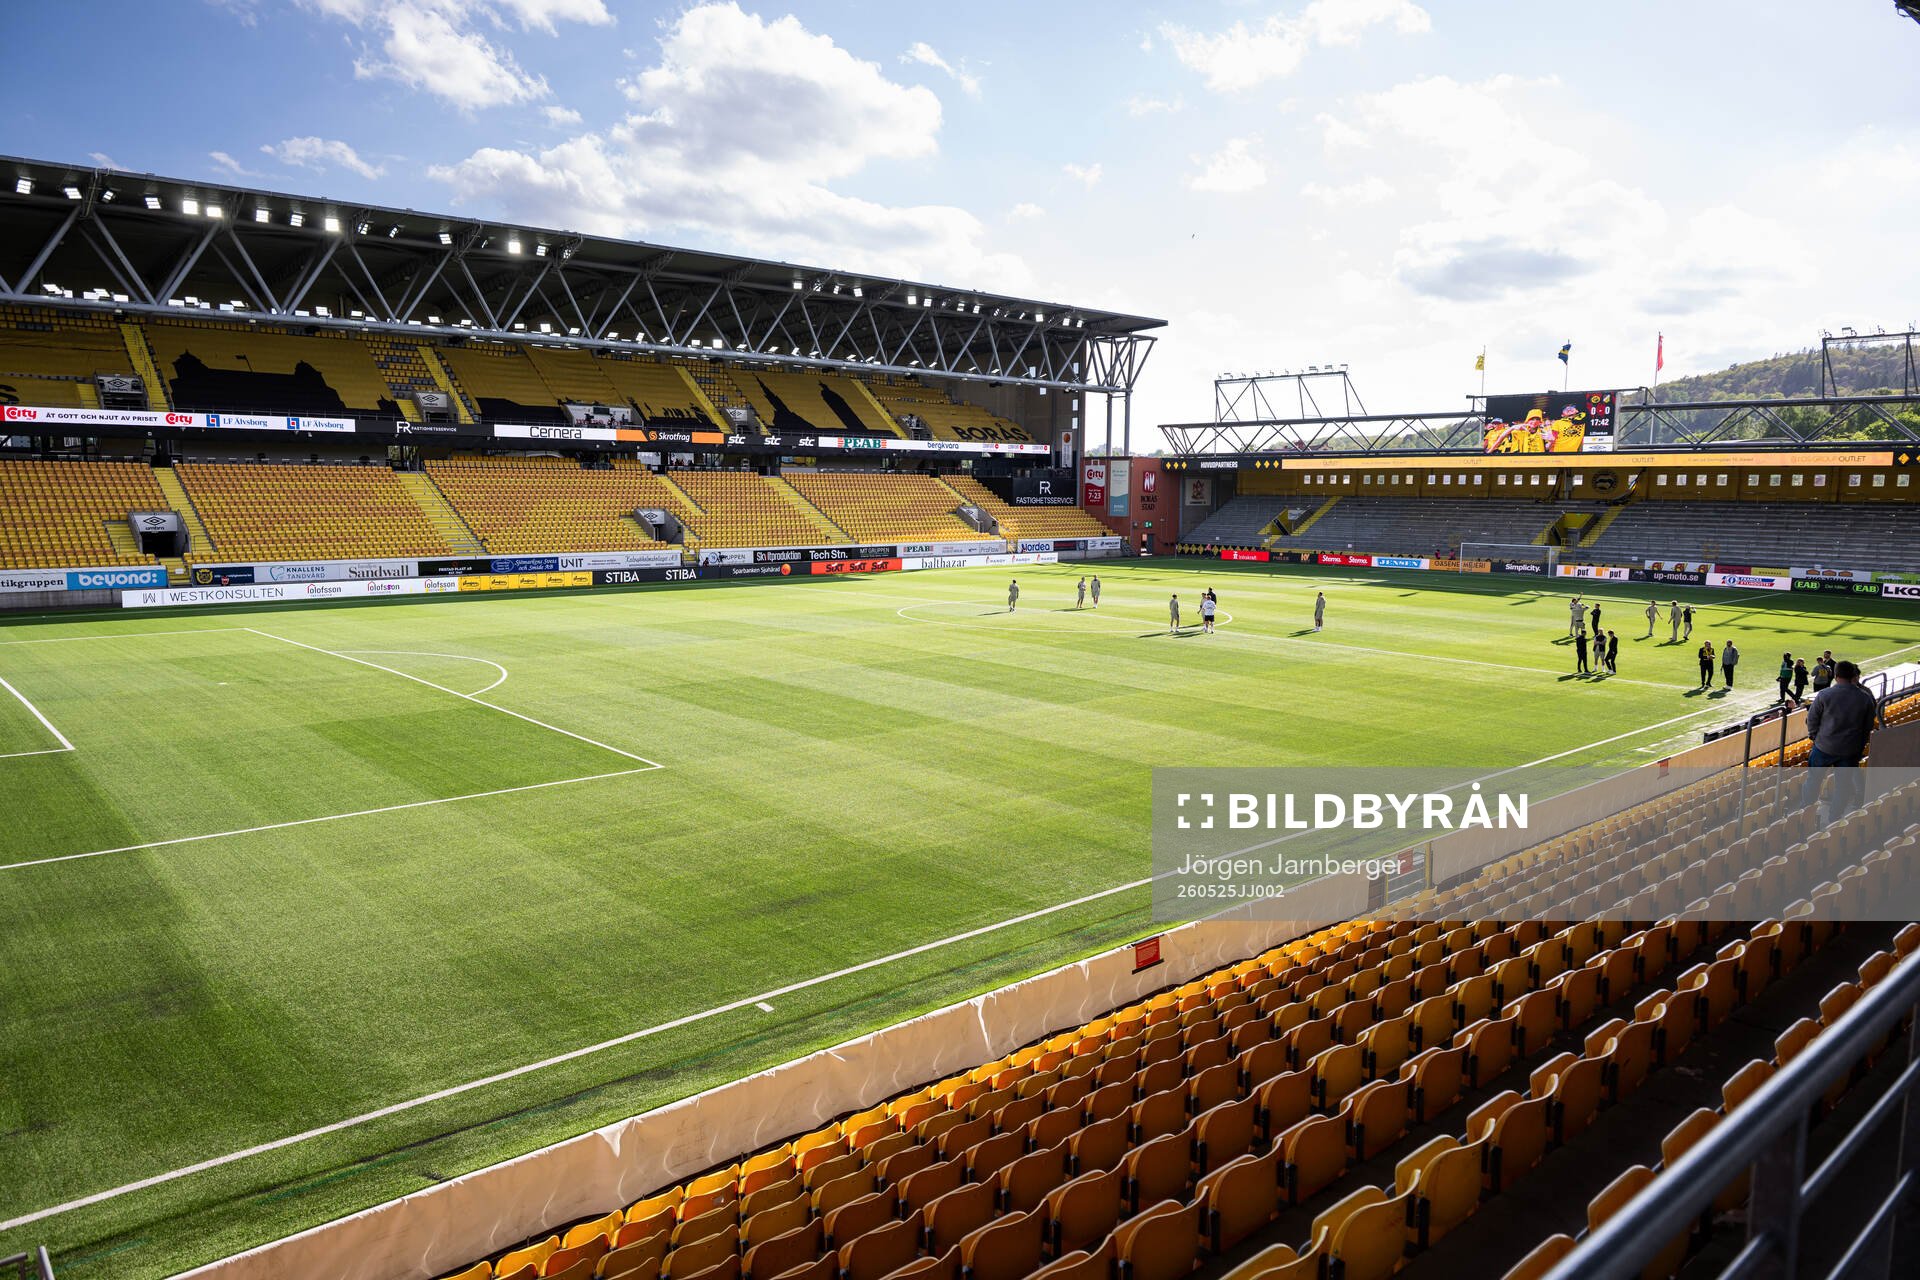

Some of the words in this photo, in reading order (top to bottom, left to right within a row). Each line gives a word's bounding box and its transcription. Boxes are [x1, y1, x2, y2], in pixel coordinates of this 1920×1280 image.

[6, 407, 37, 420] City
[58, 412, 78, 420] GOTT
[81, 413, 97, 421] OCH
[99, 414, 119, 422] NJUT
[121, 414, 131, 422] AV
[166, 413, 193, 425] City
[223, 416, 235, 425] LF
[236, 416, 268, 427] Älvsborg
[1591, 418, 1610, 426] 17:42
[302, 420, 313, 428] LF
[313, 420, 344, 429] Älvsborg
[396, 421, 412, 434] FR
[529, 427, 582, 439] Cernera
[658, 432, 690, 442] Skrotfrag
[728, 434, 746, 444] stc
[764, 436, 781, 445] stc
[798, 437, 815, 447] stc
[843, 439, 881, 448] PEAB
[1086, 470, 1104, 480] City
[1039, 480, 1052, 495] FR
[1016, 497, 1074, 505] FASTIGHETSSERVICE
[1022, 542, 1050, 552] Nordea
[809, 550, 830, 560] Tech
[831, 549, 848, 559] Stn.
[561, 558, 584, 569] UNIT
[921, 557, 966, 569] balthazar
[1379, 559, 1419, 568] JENSEN
[348, 565, 409, 579] Sandwall
[732, 567, 760, 575] Sparbanken
[1505, 564, 1541, 573] Simplicity.
[79, 571, 157, 587] beyond:
[605, 571, 640, 583] STIBA
[665, 569, 697, 581] STIBA
[1653, 572, 1699, 582] up-moto.se
[1, 578, 64, 589] tikgruppen
[369, 582, 400, 591] olofsson
[426, 579, 456, 589] olofsson
[1798, 581, 1818, 589] EAB
[309, 584, 342, 594] olofsson
[1856, 585, 1877, 593] EAB
[169, 587, 284, 602] WESTKONSULTEN
